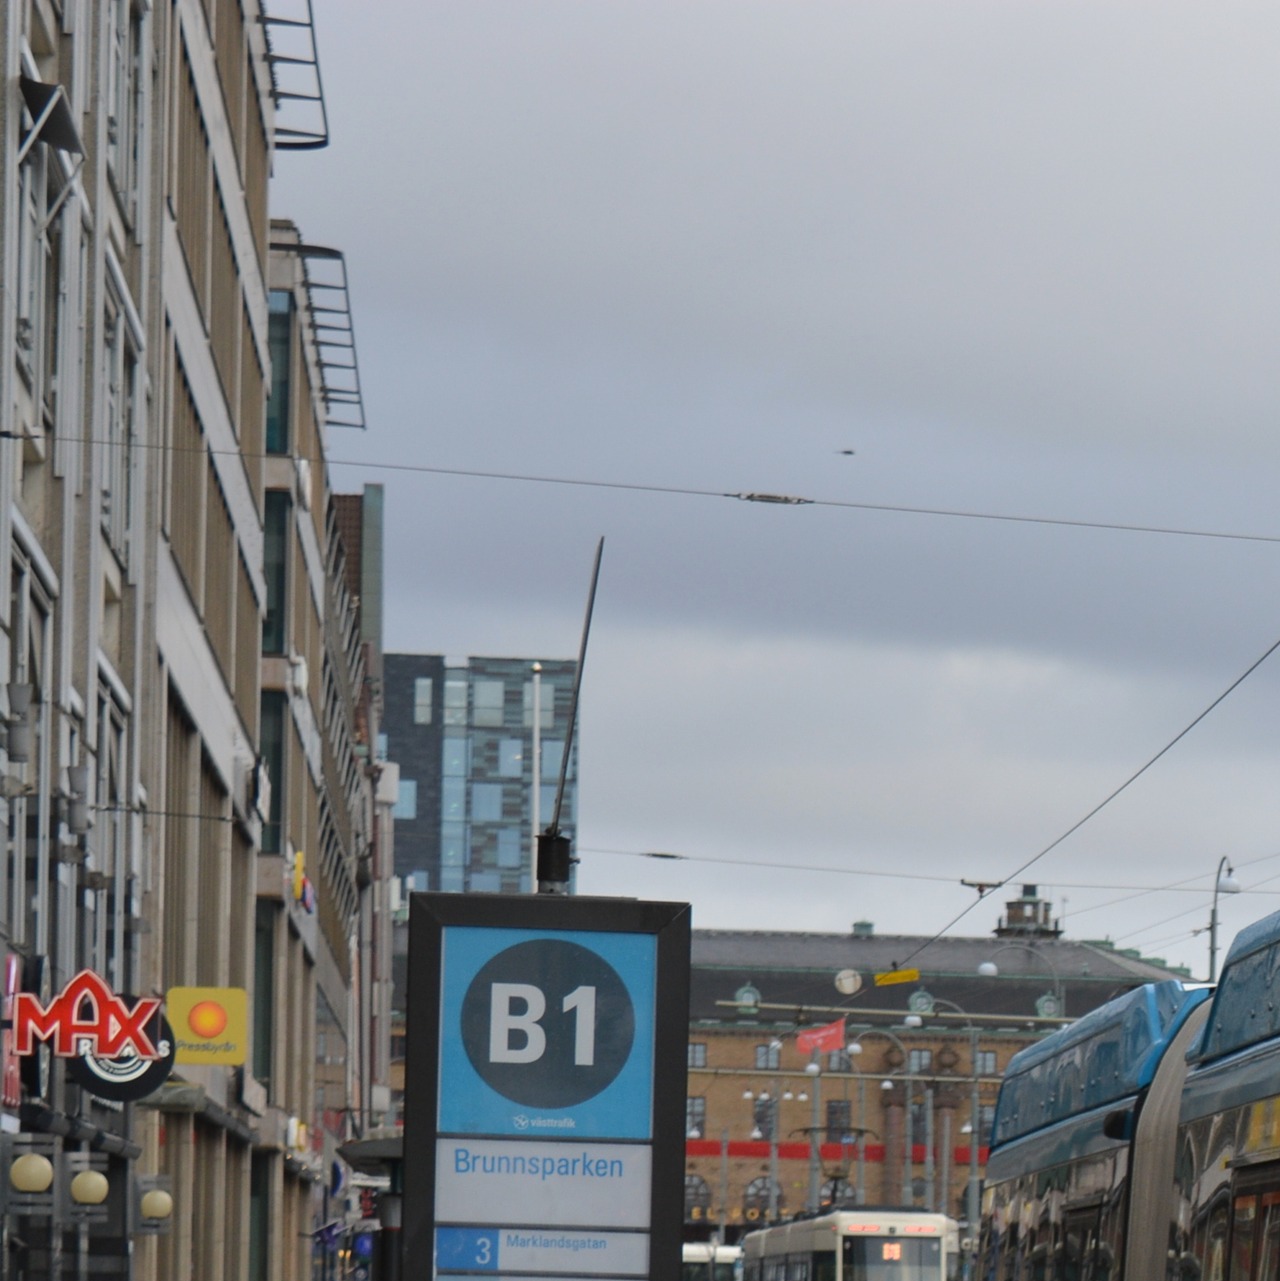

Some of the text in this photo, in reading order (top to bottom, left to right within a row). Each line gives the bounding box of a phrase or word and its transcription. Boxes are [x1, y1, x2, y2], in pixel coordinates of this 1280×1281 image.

[13, 968, 163, 1061] MAX
[530, 1117, 576, 1129] västtrafik
[454, 1148, 624, 1181] Brunnsparken
[475, 1234, 607, 1265] 3 Marklandsgatan
